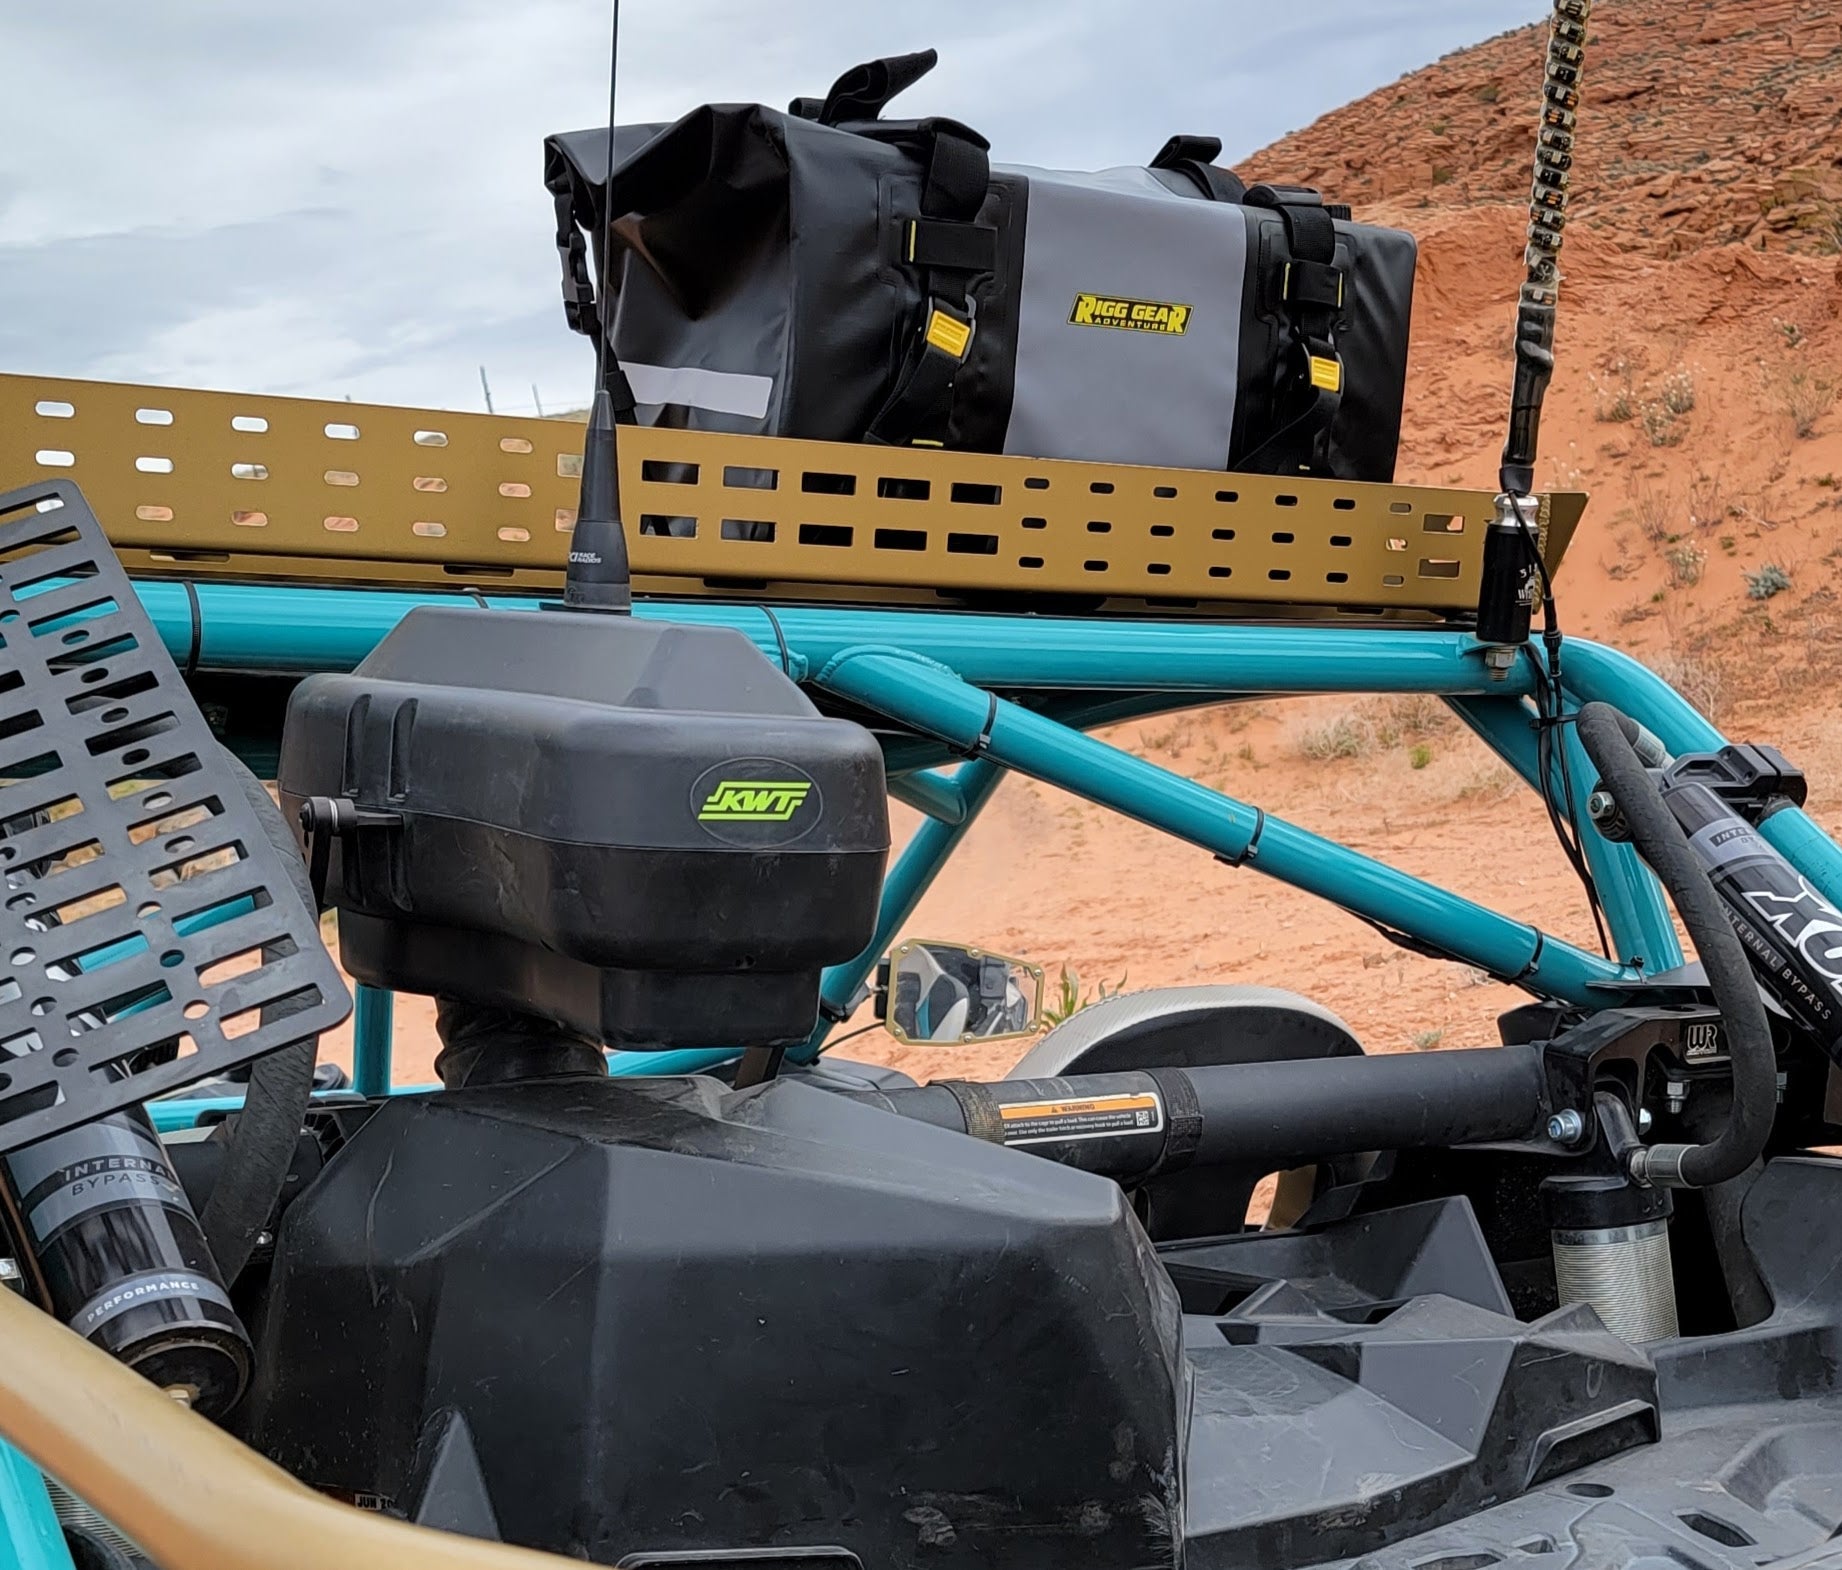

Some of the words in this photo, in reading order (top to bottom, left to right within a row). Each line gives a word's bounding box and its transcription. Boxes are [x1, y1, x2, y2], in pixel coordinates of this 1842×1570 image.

[1075, 296, 1129, 323] RIGG
[1131, 305, 1186, 332] GEAR
[1094, 317, 1166, 331] ADVENTURE
[701, 788, 809, 813] KWT
[1720, 900, 1778, 968] NTERNAL
[1782, 967, 1832, 1020] BYPASS
[1060, 1103, 1096, 1113] WARNING
[64, 1157, 174, 1182] INTERNAL
[72, 1173, 160, 1196] BYPASS
[87, 1281, 200, 1323] PERFORMANCE
